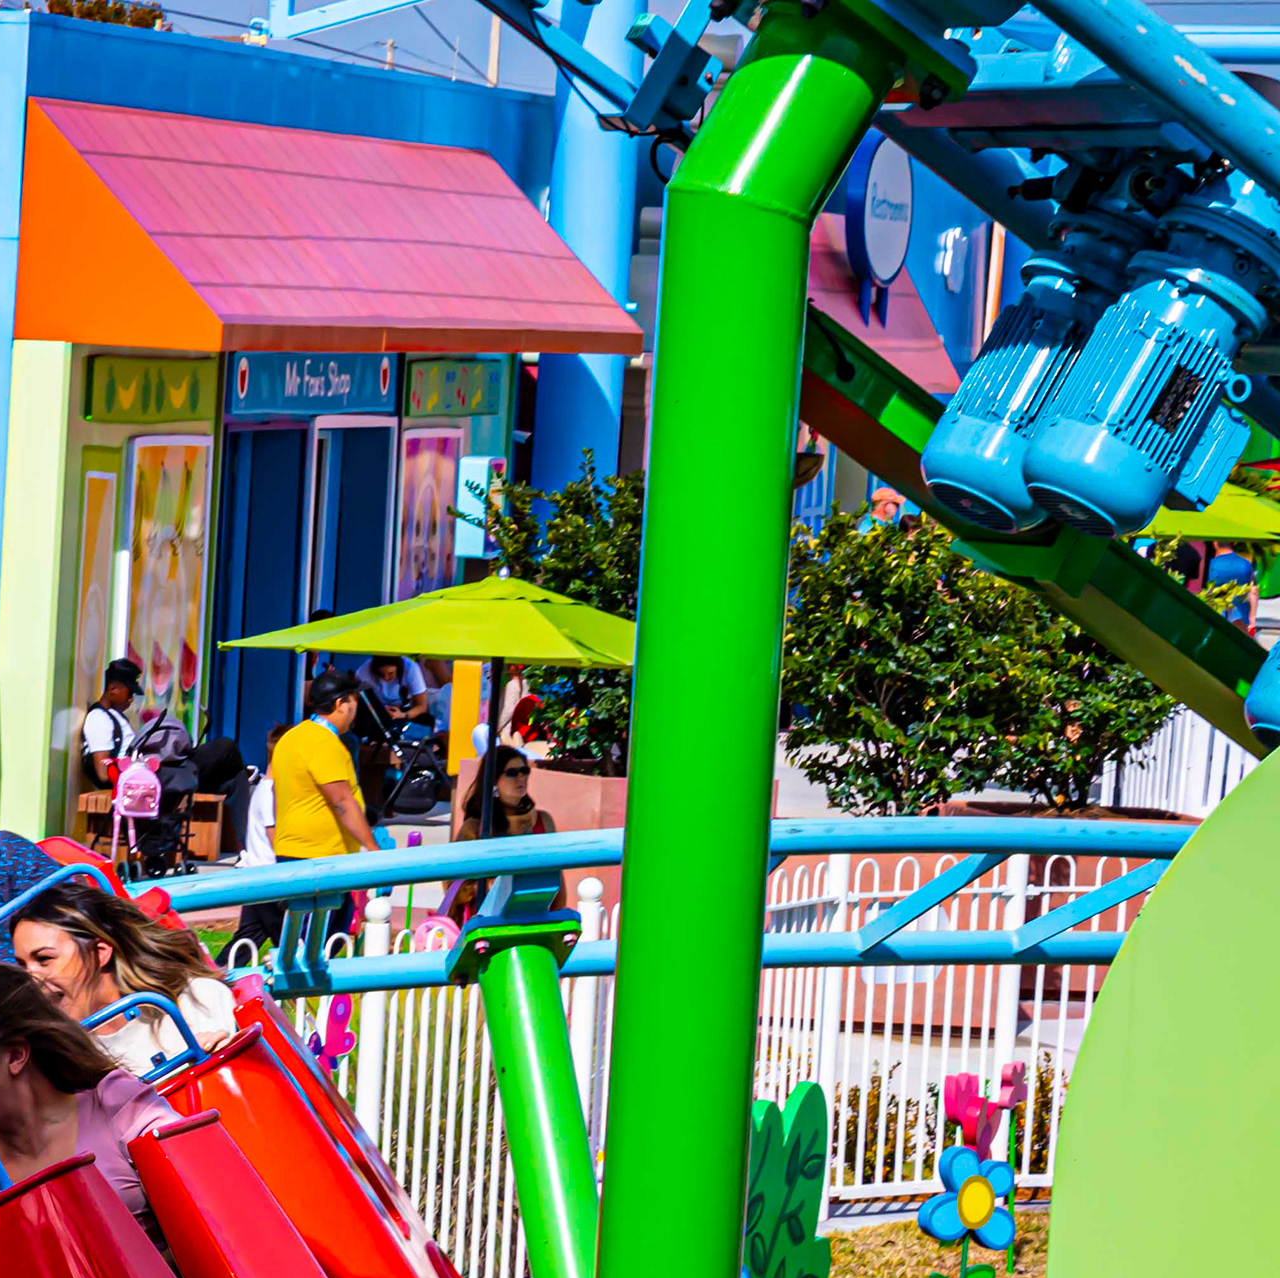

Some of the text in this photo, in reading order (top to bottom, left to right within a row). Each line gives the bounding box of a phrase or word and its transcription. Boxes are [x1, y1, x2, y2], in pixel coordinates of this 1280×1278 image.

[284, 358, 351, 406] Mr Fox's Shop
